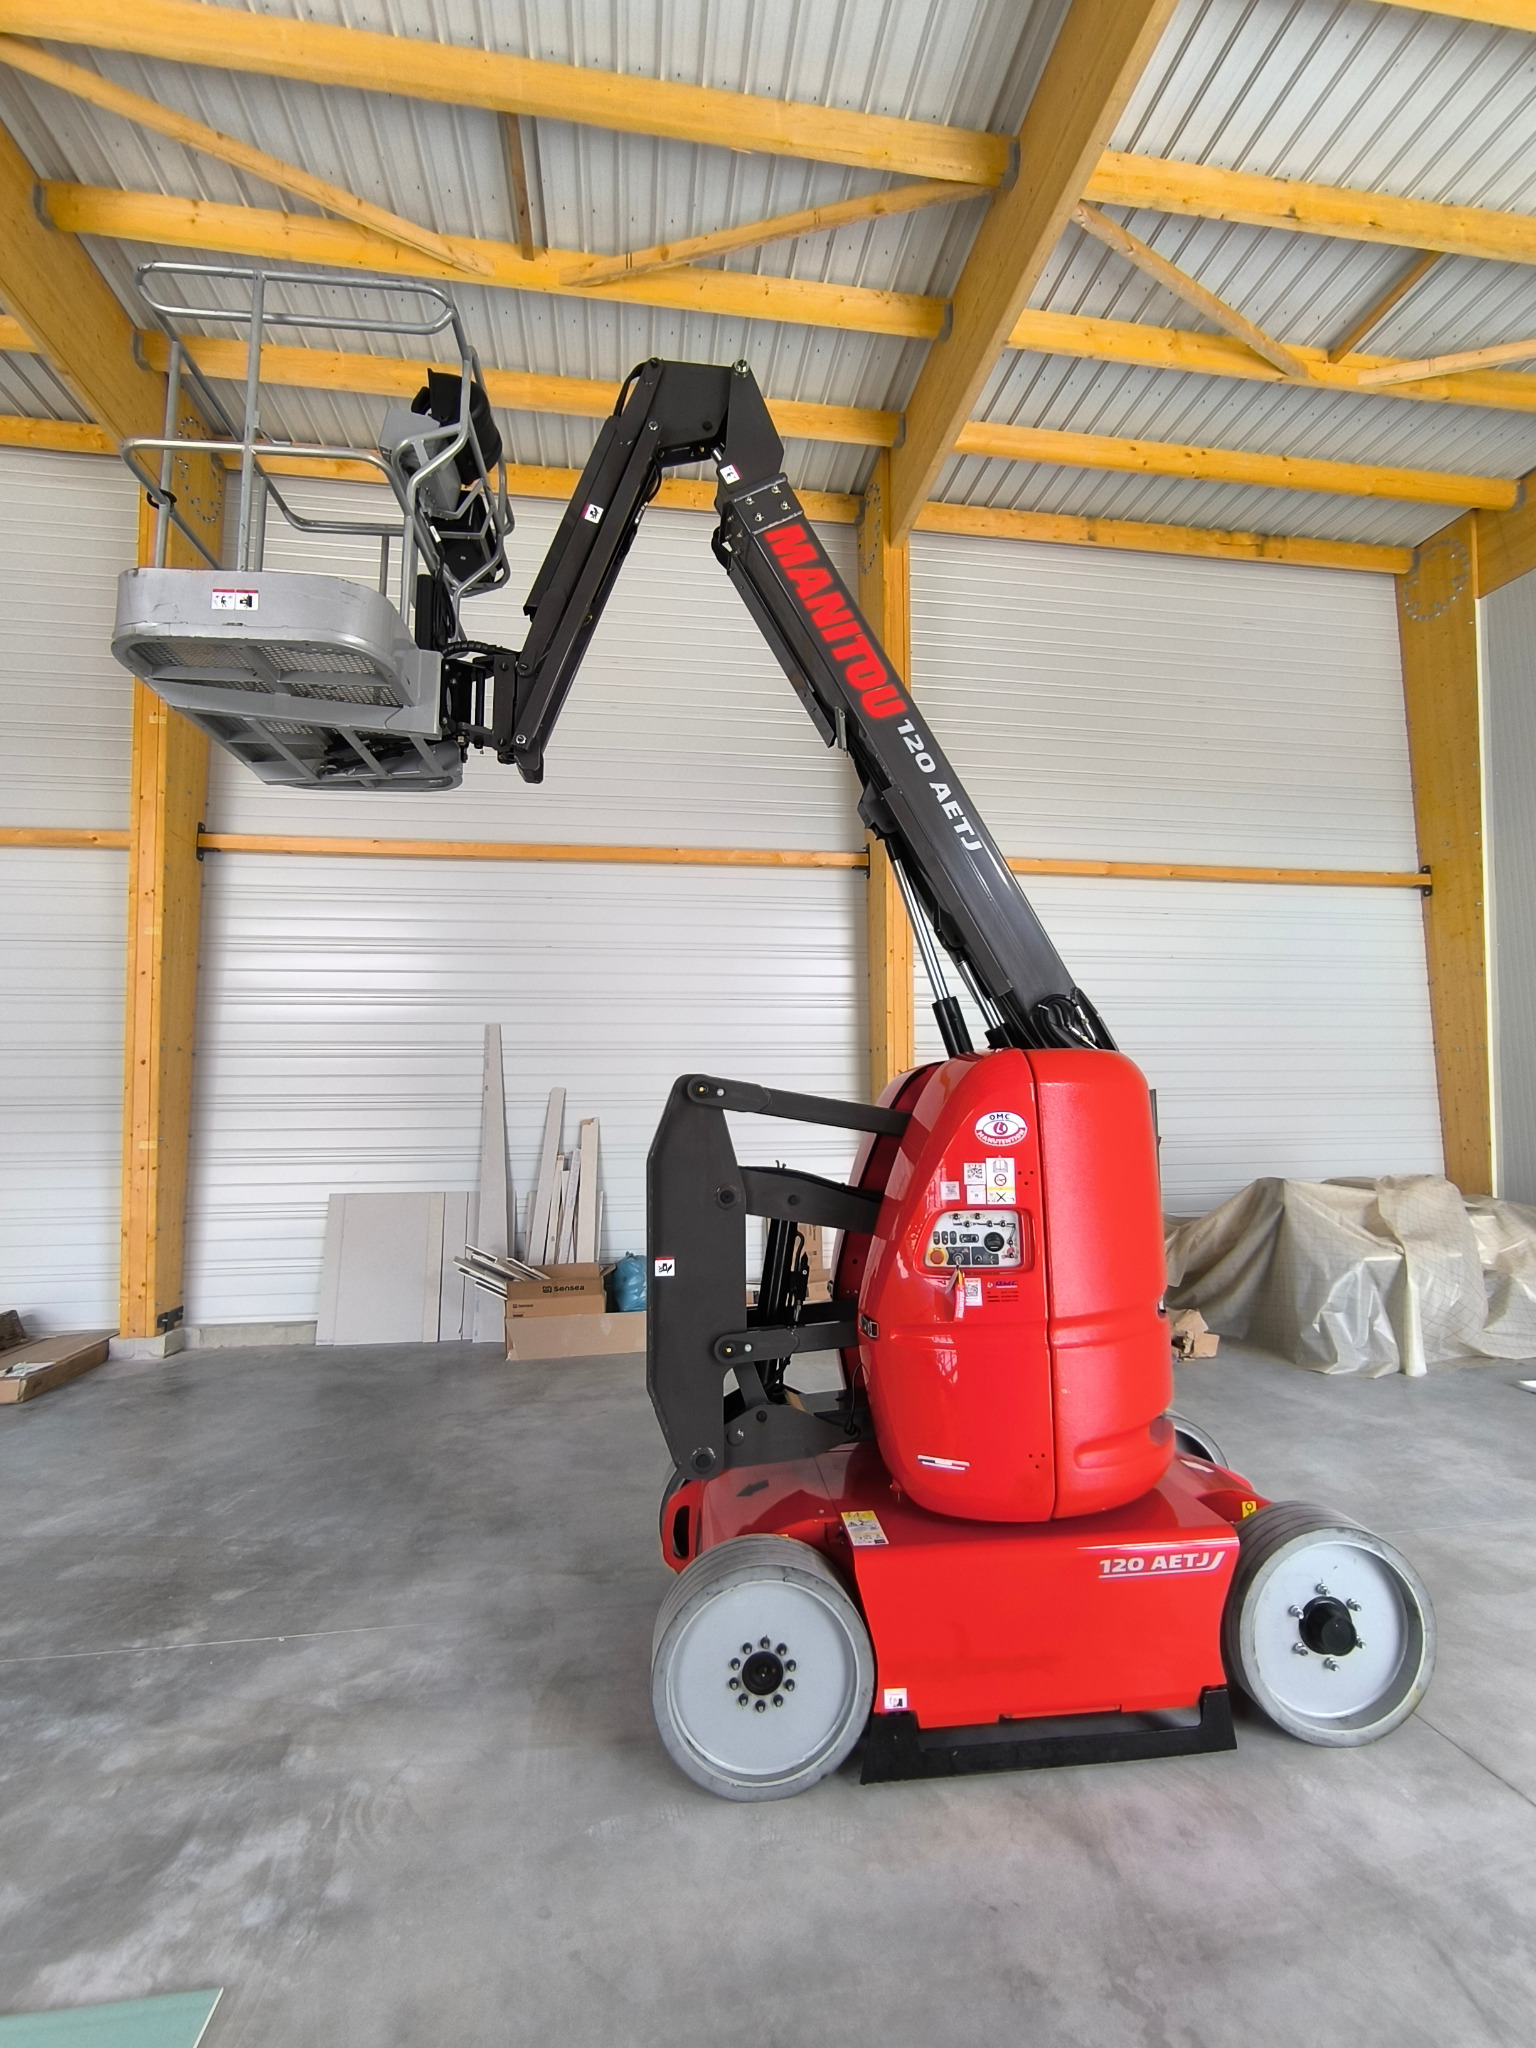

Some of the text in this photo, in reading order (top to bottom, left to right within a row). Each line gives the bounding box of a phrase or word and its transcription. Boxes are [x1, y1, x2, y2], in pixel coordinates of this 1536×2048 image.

[763, 523, 909, 719] MANITOU
[897, 718, 983, 851] 120 AETJ
[989, 1113, 1010, 1121] OMC
[1099, 1552, 1210, 1574] 120 AETJ
